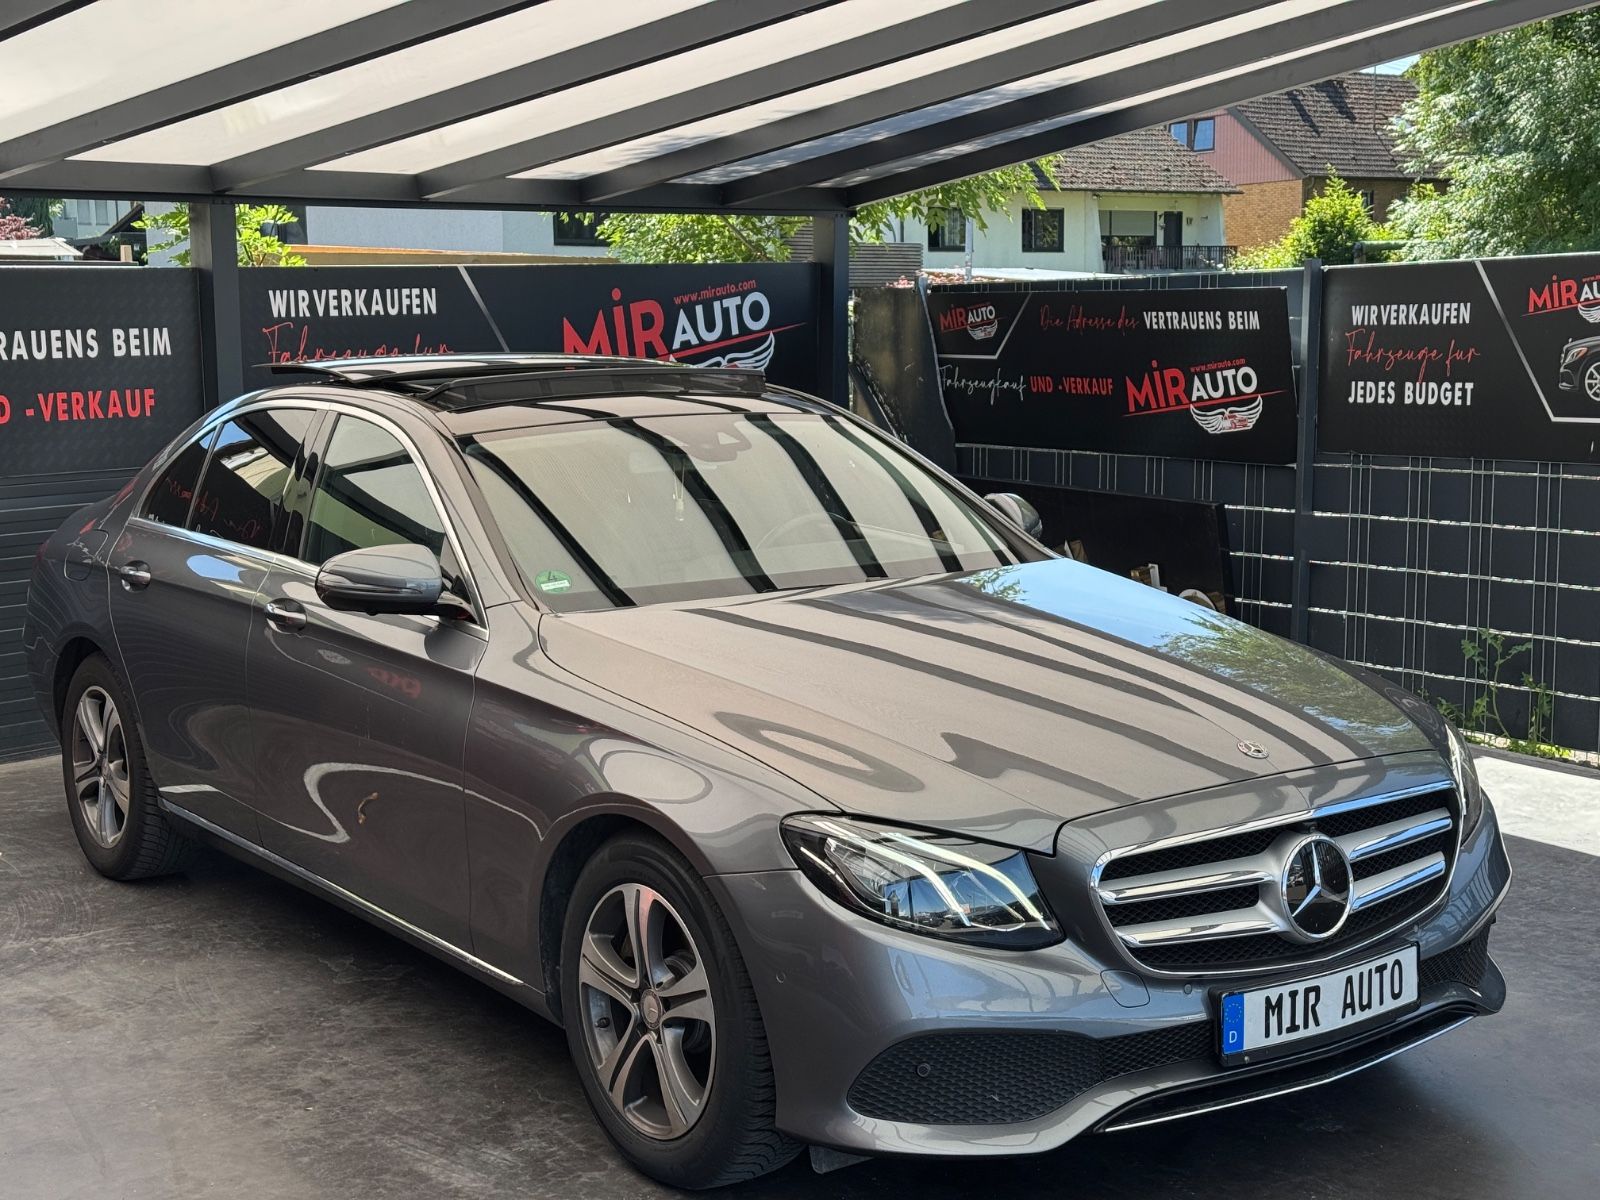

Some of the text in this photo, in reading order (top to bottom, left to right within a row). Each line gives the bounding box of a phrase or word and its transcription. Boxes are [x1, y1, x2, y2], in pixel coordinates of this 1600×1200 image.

[673, 279, 757, 305] www.mirauto.com
[672, 291, 771, 350] AUTO
[968, 305, 996, 324] AUTO
[1143, 310, 1223, 330] VERTRAUENS
[1228, 310, 1260, 330] BEIM
[112, 327, 172, 357] BEIM
[1345, 328, 1443, 384] Fahrzeuge
[939, 364, 1027, 405] Fahrzeugkauf
[1029, 376, 1053, 394] UND
[1191, 366, 1258, 402] AUTO
[1348, 381, 1474, 406] JEDES BUDGET
[1264, 958, 1403, 1038] MIR AUTO
[1229, 1030, 1238, 1044] D
